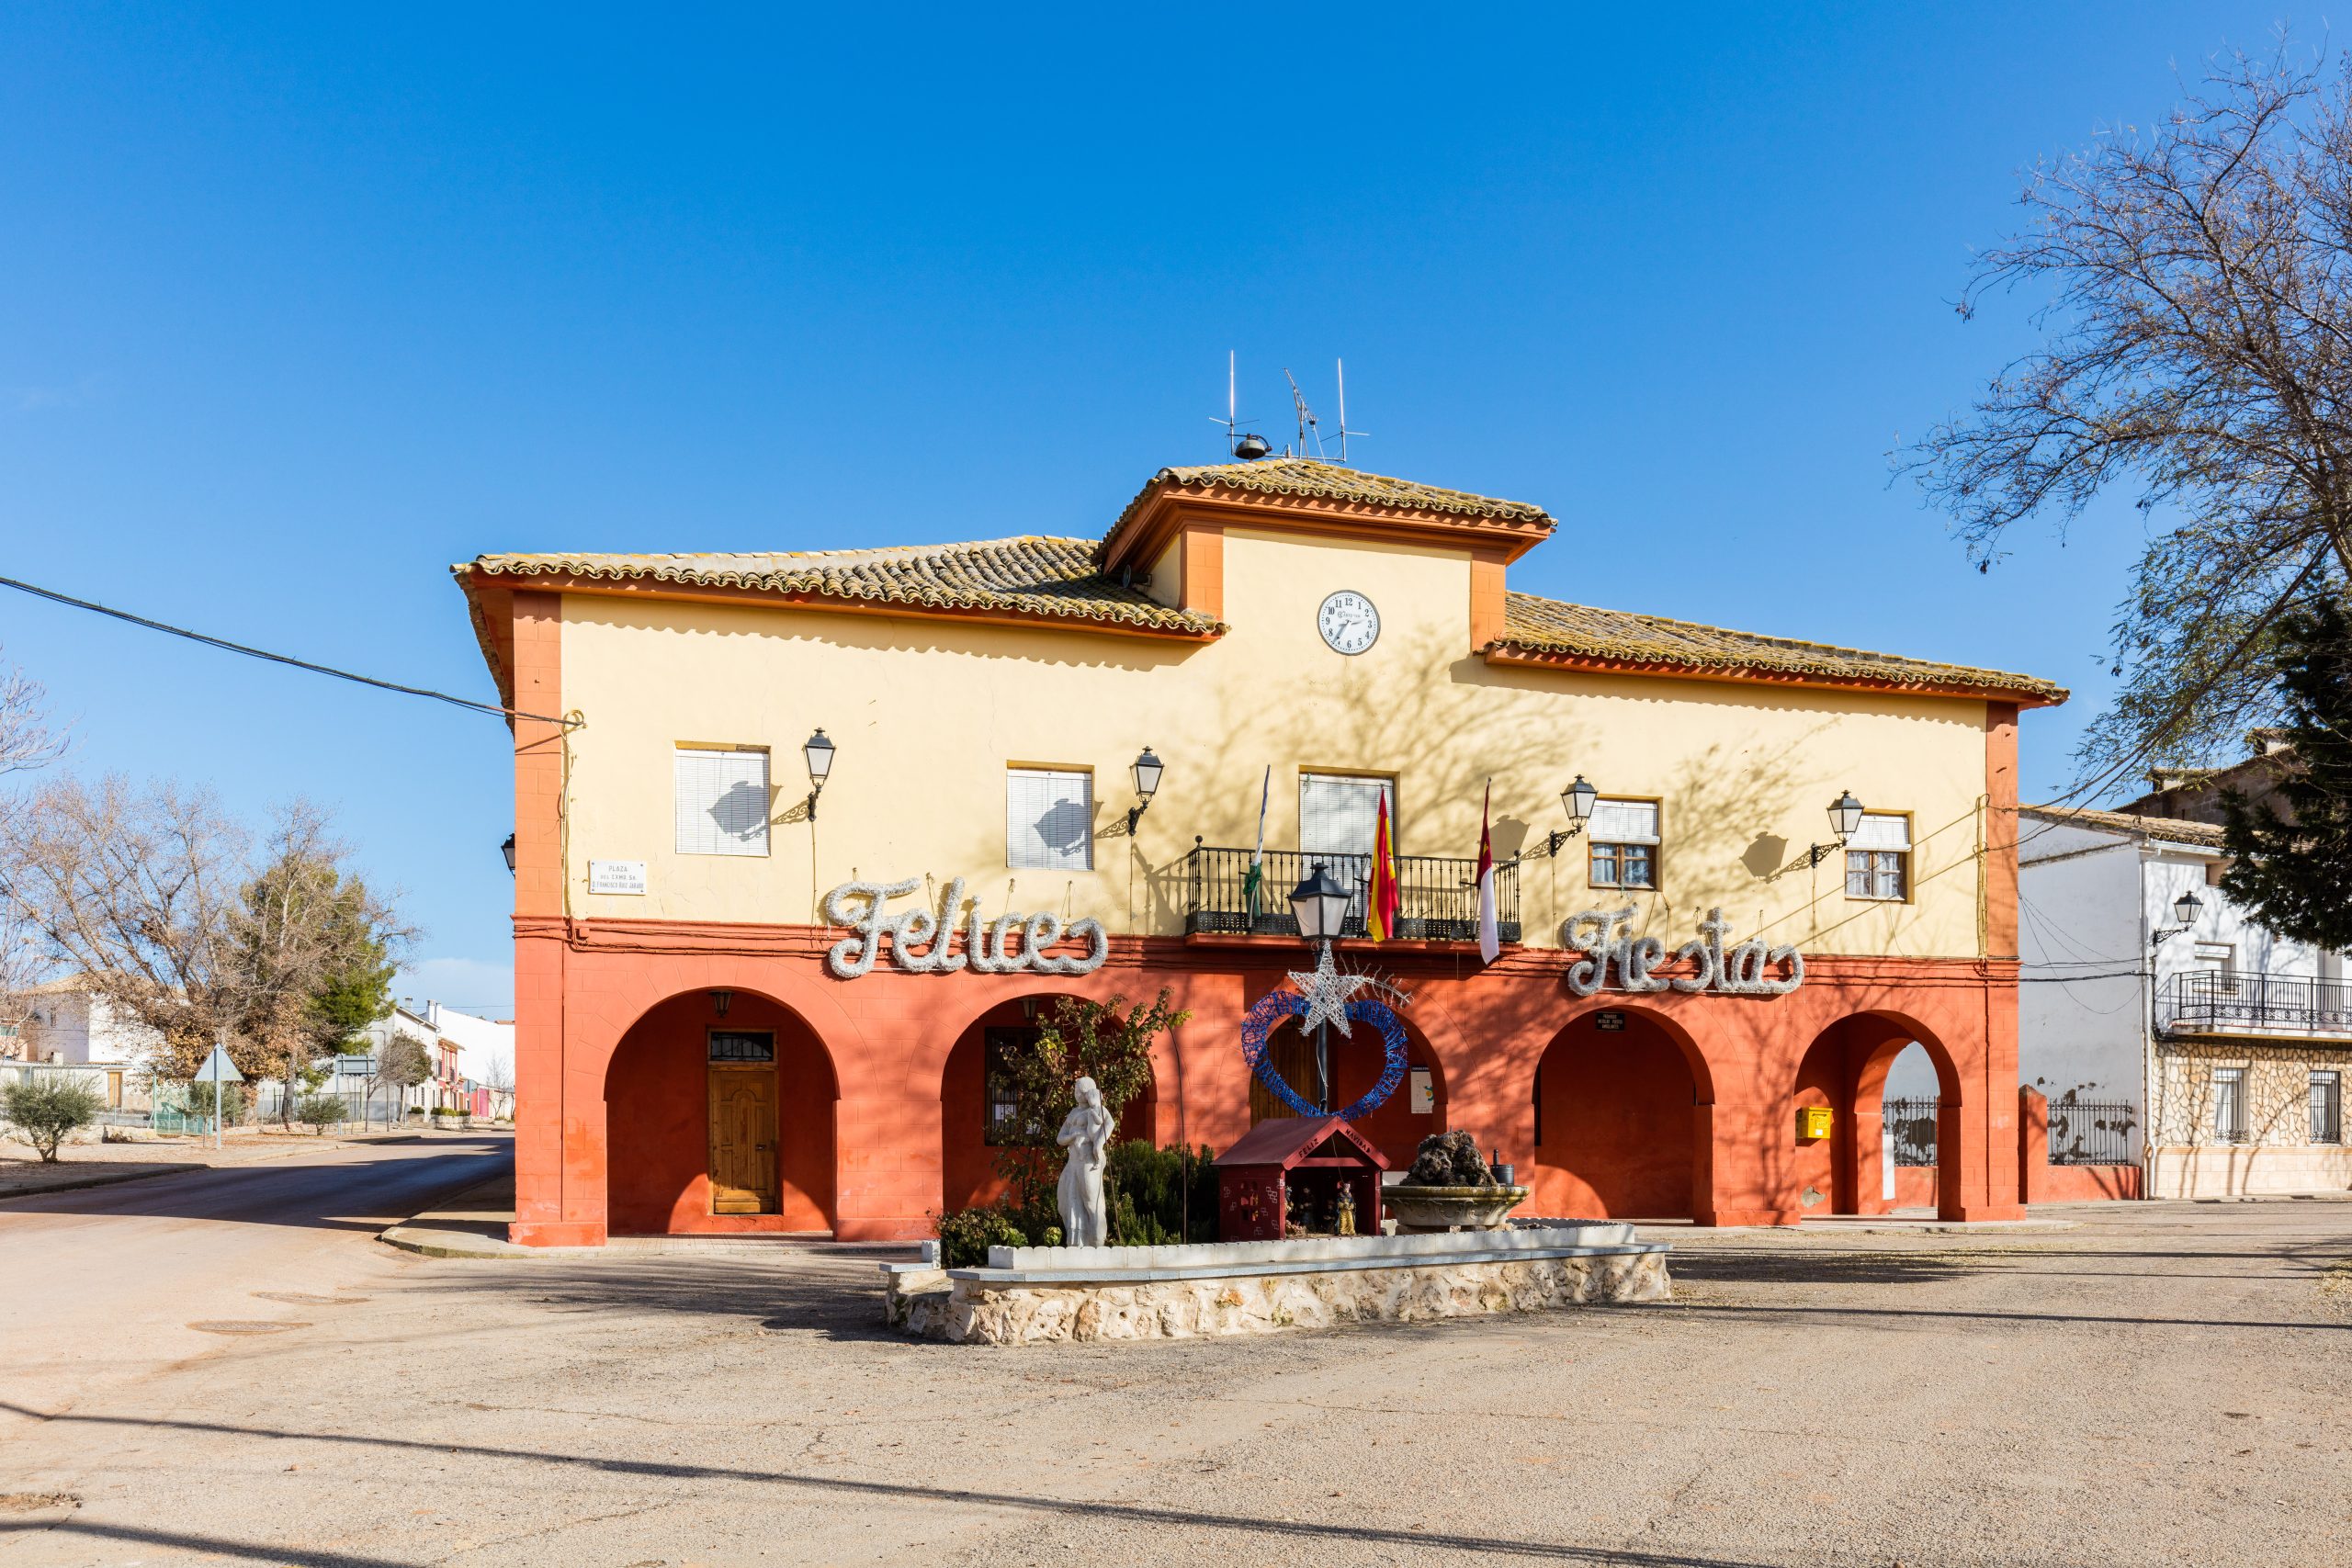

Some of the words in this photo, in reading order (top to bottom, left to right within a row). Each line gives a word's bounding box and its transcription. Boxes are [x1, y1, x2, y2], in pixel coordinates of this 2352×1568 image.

[1335, 600, 1341, 608] 11
[1345, 598, 1352, 606] 12
[1368, 620, 1372, 628] 3
[1329, 628, 1333, 637] 8
[1365, 631, 1370, 639] 4
[1347, 640, 1351, 649] 6
[1358, 637, 1362, 646] 5
[826, 876, 1108, 978] Felices
[1564, 904, 1804, 996] Fiestas
[1298, 1138, 1319, 1158] FELIZ
[1345, 1129, 1371, 1153] NAVIDAD
